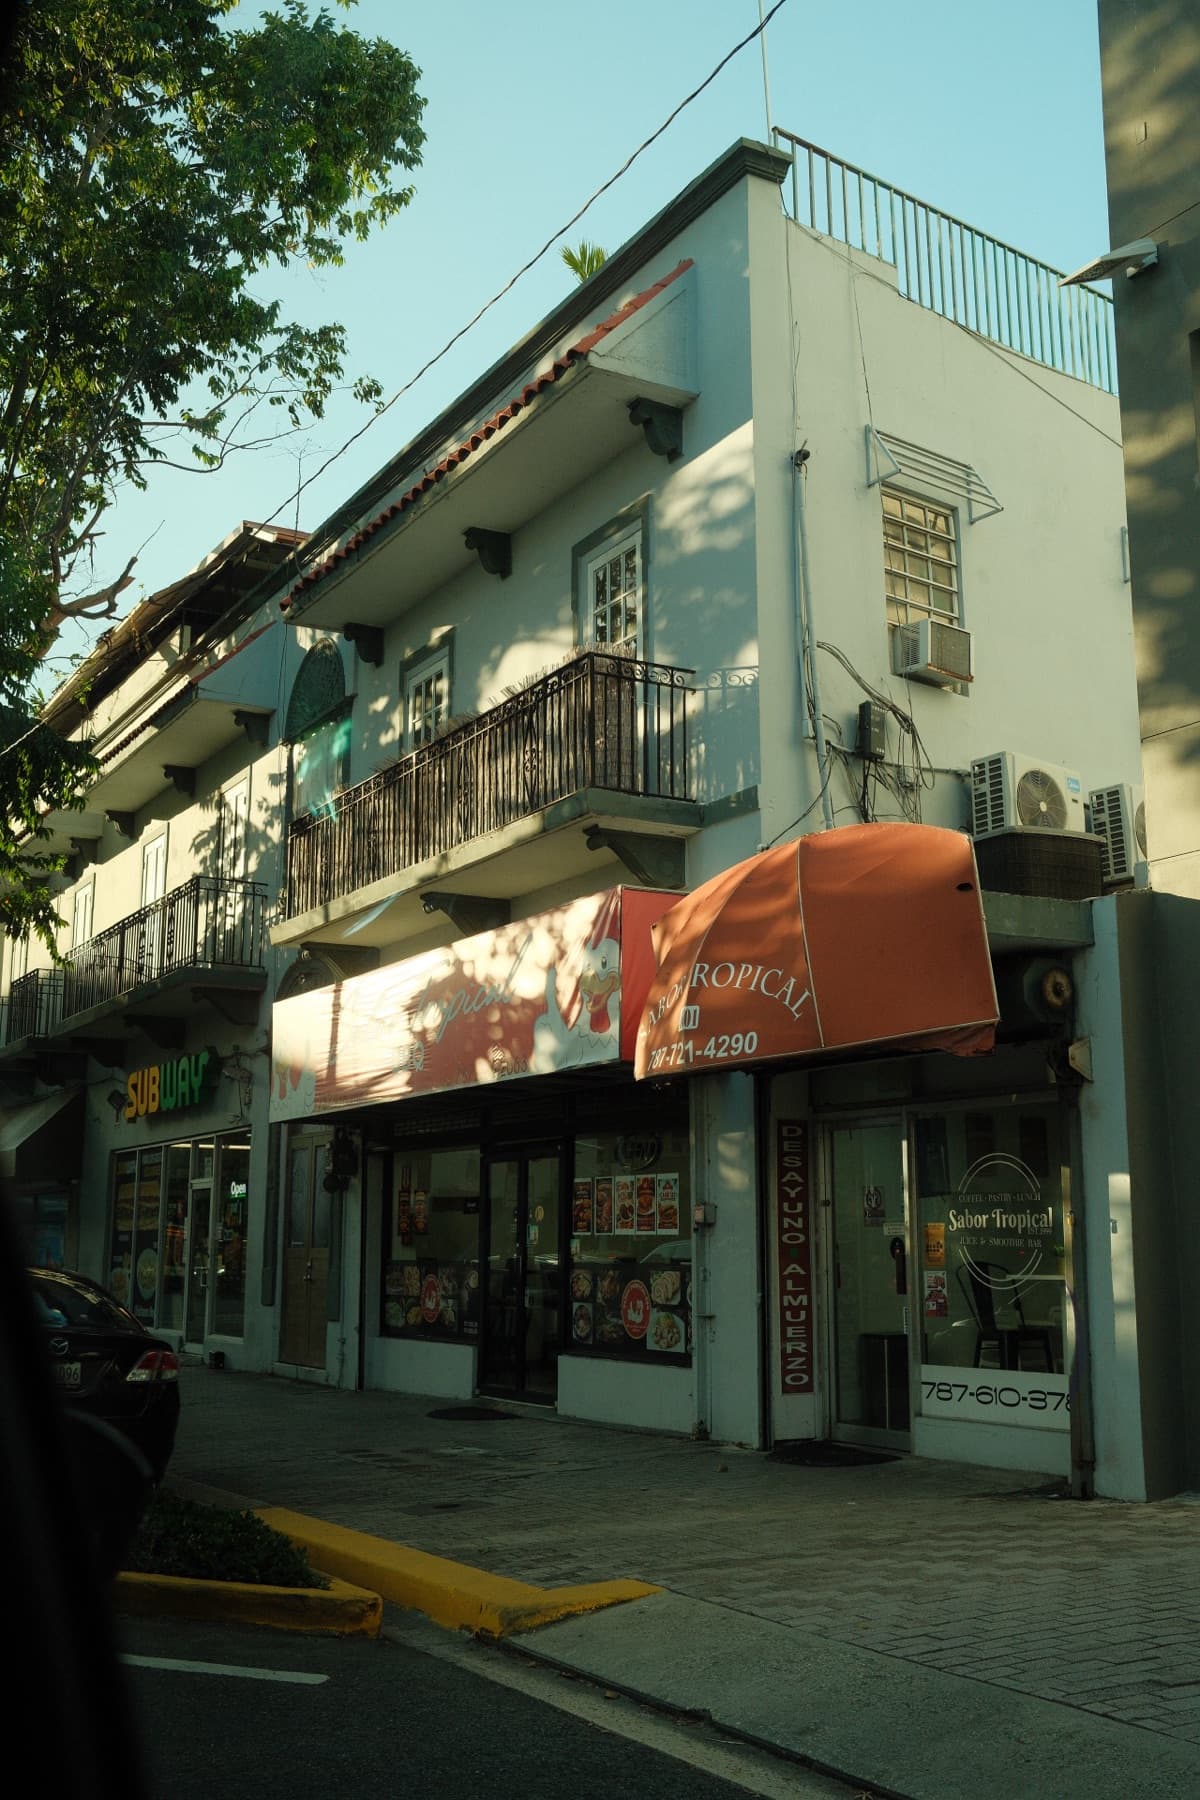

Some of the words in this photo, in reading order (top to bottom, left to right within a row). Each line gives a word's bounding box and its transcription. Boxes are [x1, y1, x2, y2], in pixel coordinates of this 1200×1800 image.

[647, 1031, 758, 1071] 787-721-4290
[125, 1051, 208, 1118] SUBWAY
[230, 1180, 247, 1198] Open
[782, 1124, 805, 1244] DESAYUNO
[948, 1209, 989, 1232] Sabor
[991, 1206, 1054, 1235] Tropical
[1026, 1239, 1043, 1249] BAR
[783, 1263, 809, 1386] ALMUERZO
